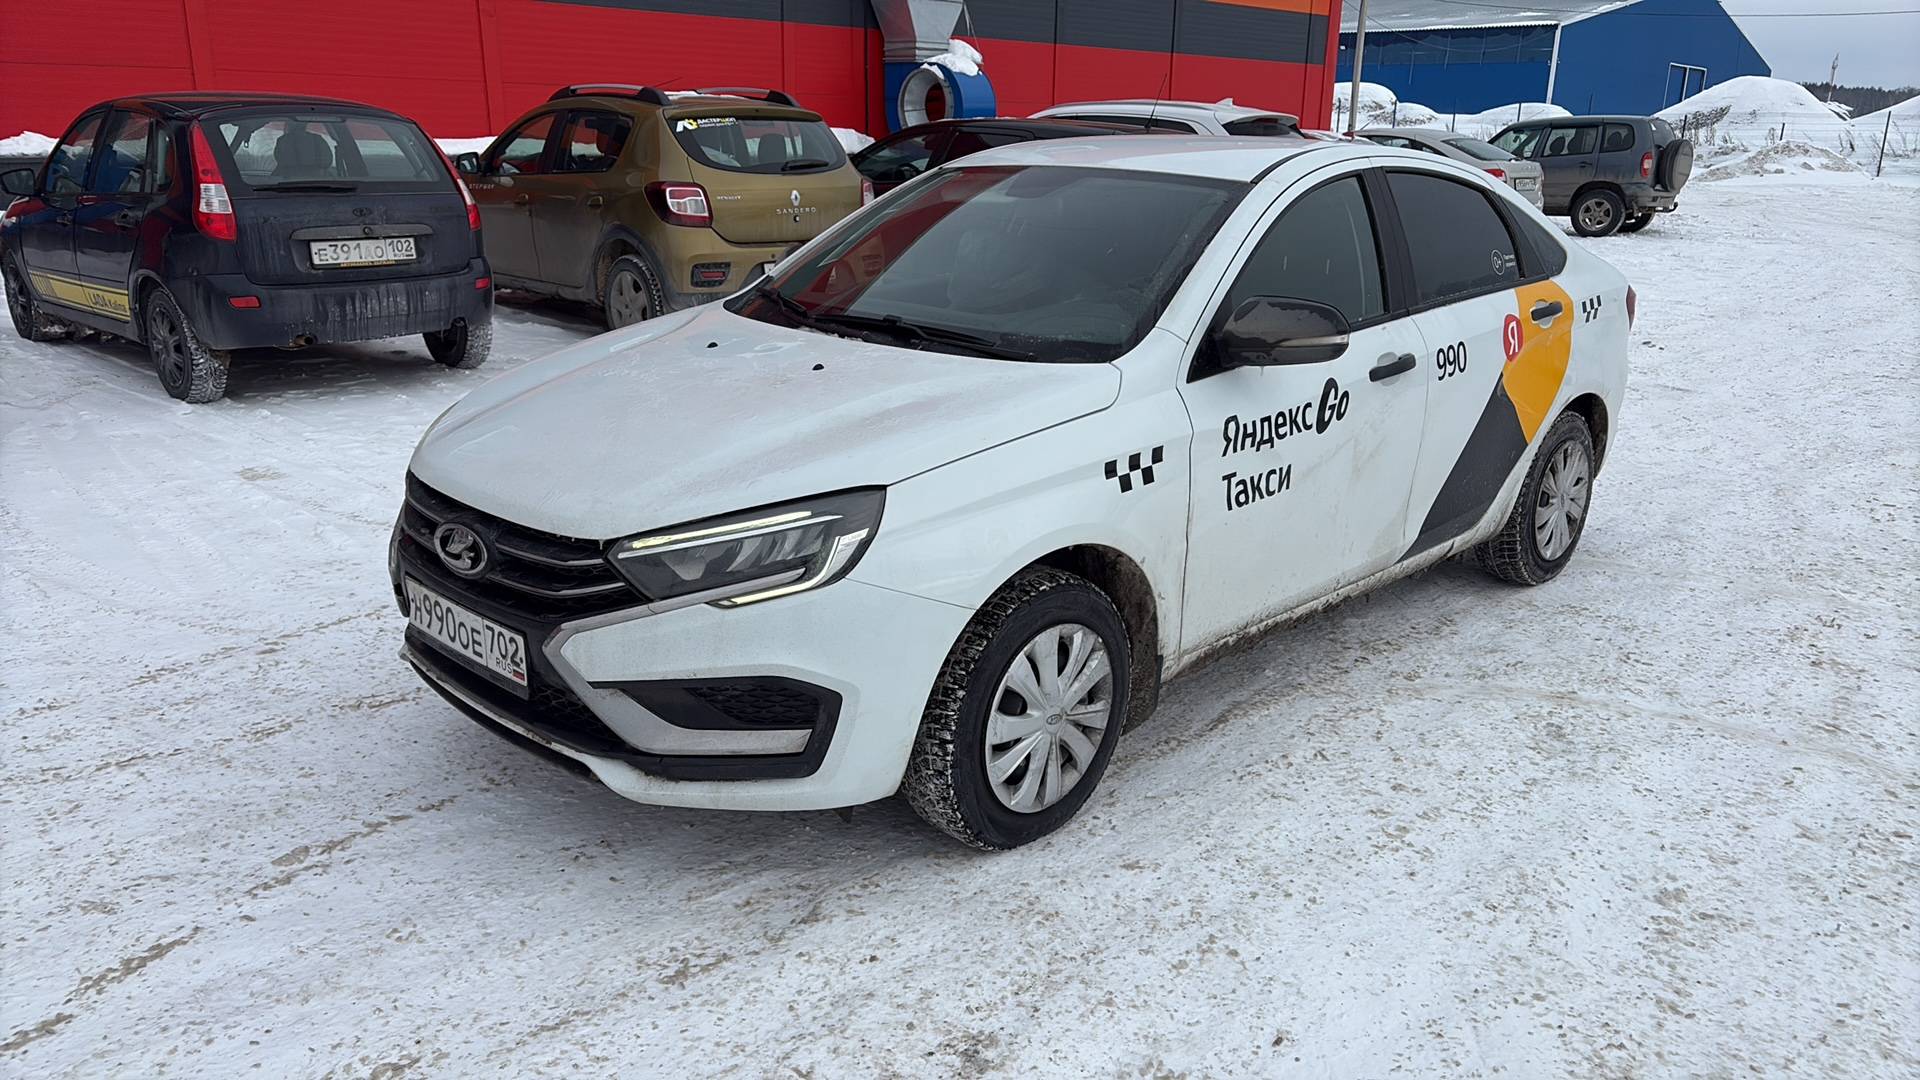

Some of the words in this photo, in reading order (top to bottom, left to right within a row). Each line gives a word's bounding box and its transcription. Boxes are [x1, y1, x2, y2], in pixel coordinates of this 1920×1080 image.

[776, 207, 817, 215] SANDERO
[388, 239, 413, 253] 102
[87, 292, 110, 308] LADA
[1507, 320, 1519, 356] Я
[1435, 340, 1468, 382] 990
[1221, 401, 1313, 457] Яндекс
[1315, 377, 1350, 435] Go
[1221, 463, 1292, 512] Такси
[485, 624, 521, 668] 702
[495, 657, 513, 675] RUS
